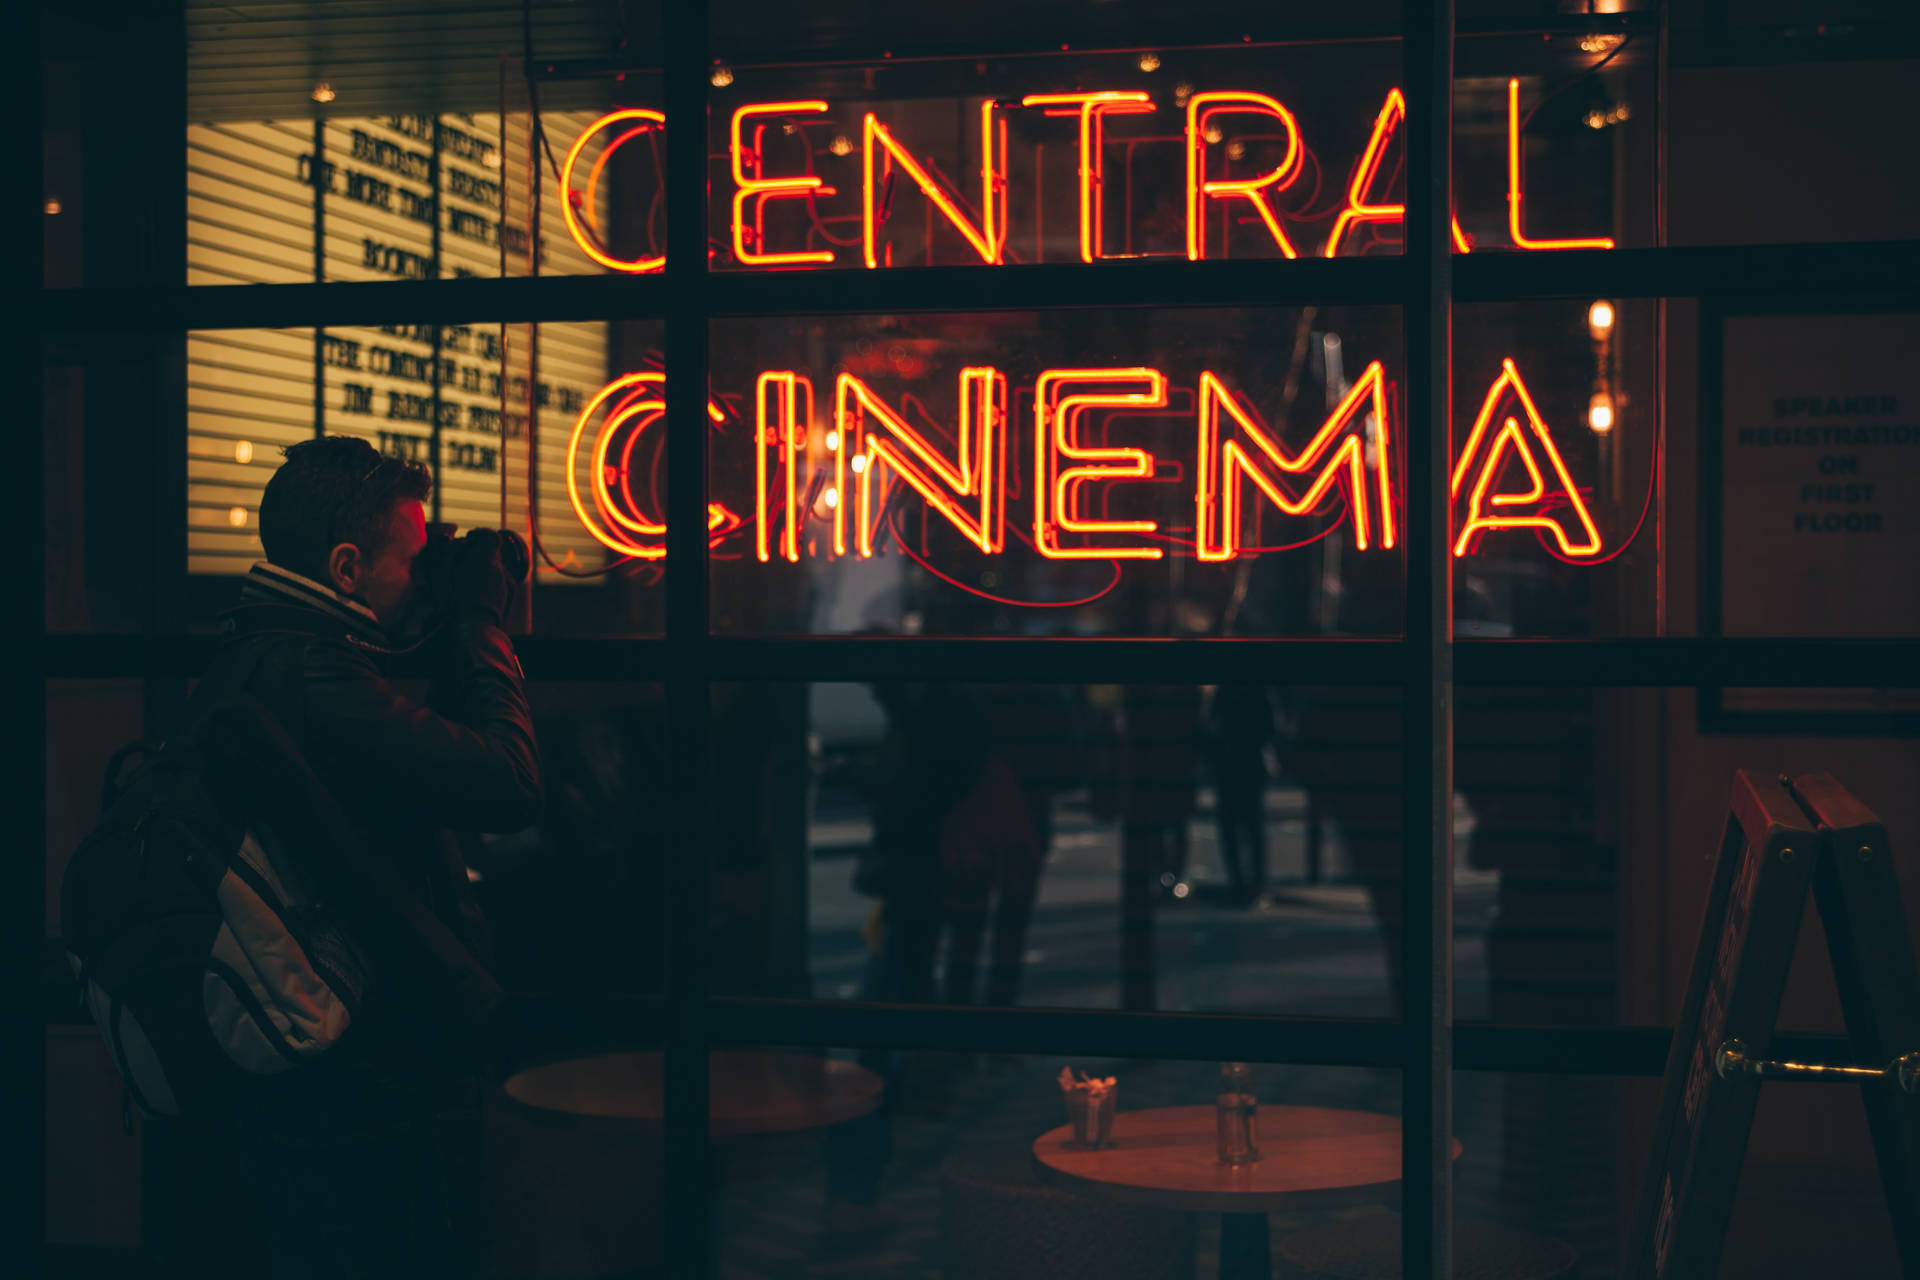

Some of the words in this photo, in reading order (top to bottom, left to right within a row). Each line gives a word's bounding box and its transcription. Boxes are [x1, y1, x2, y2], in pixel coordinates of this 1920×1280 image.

[559, 78, 1616, 273] CENTRAL
[1773, 396, 1898, 418] SPEAKER
[565, 356, 1603, 563] CINEMA
[1818, 455, 1859, 475] ON
[1800, 484, 1876, 504] FIRST
[1794, 512, 1883, 534] FLOOR
